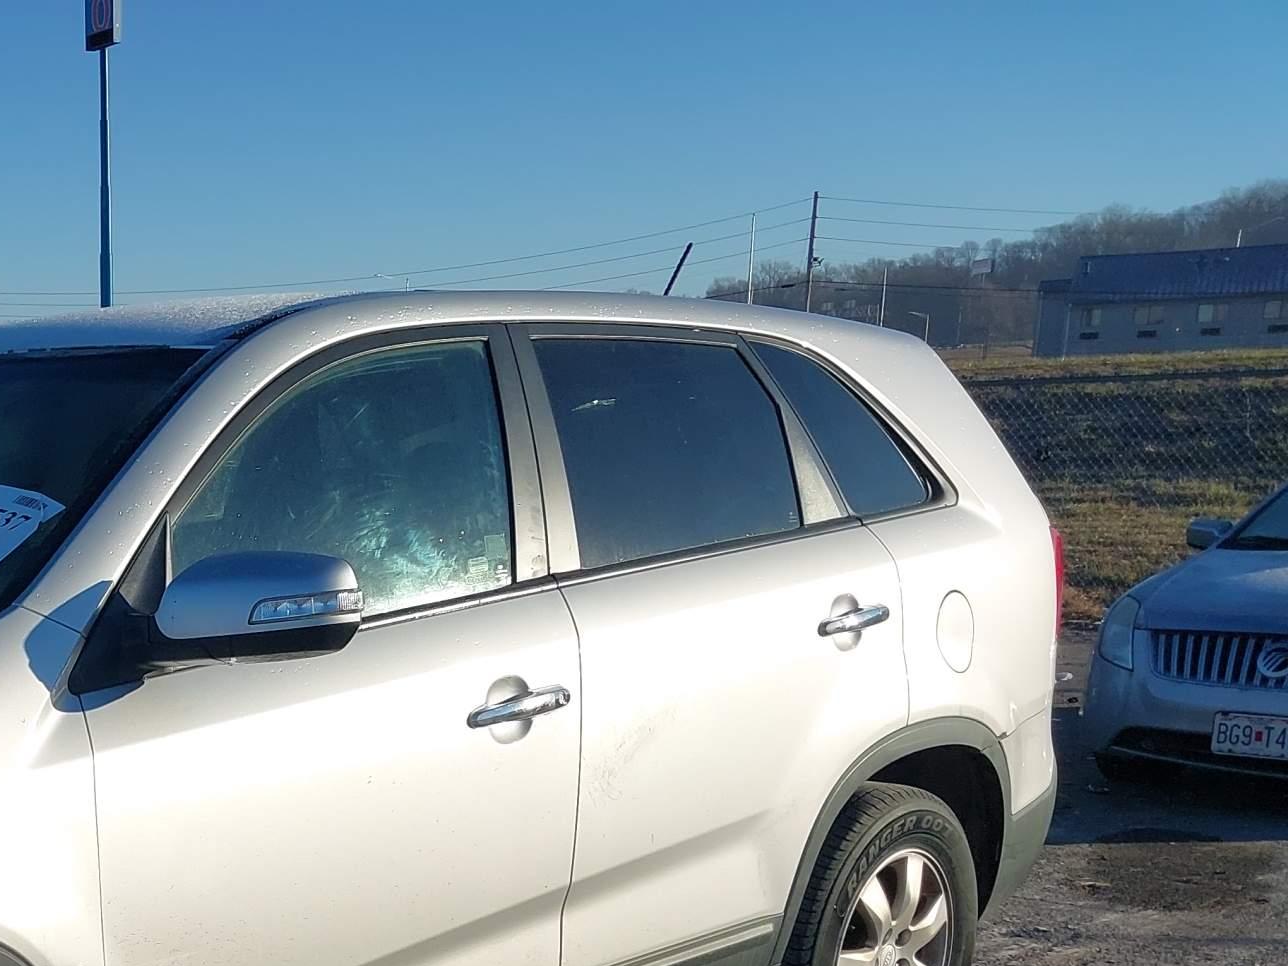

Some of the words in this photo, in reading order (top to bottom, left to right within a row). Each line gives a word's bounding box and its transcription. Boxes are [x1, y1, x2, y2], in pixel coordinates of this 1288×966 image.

[1216, 722, 1253, 746] BG9
[846, 815, 918, 899] RANGER
[921, 815, 952, 840] 007
